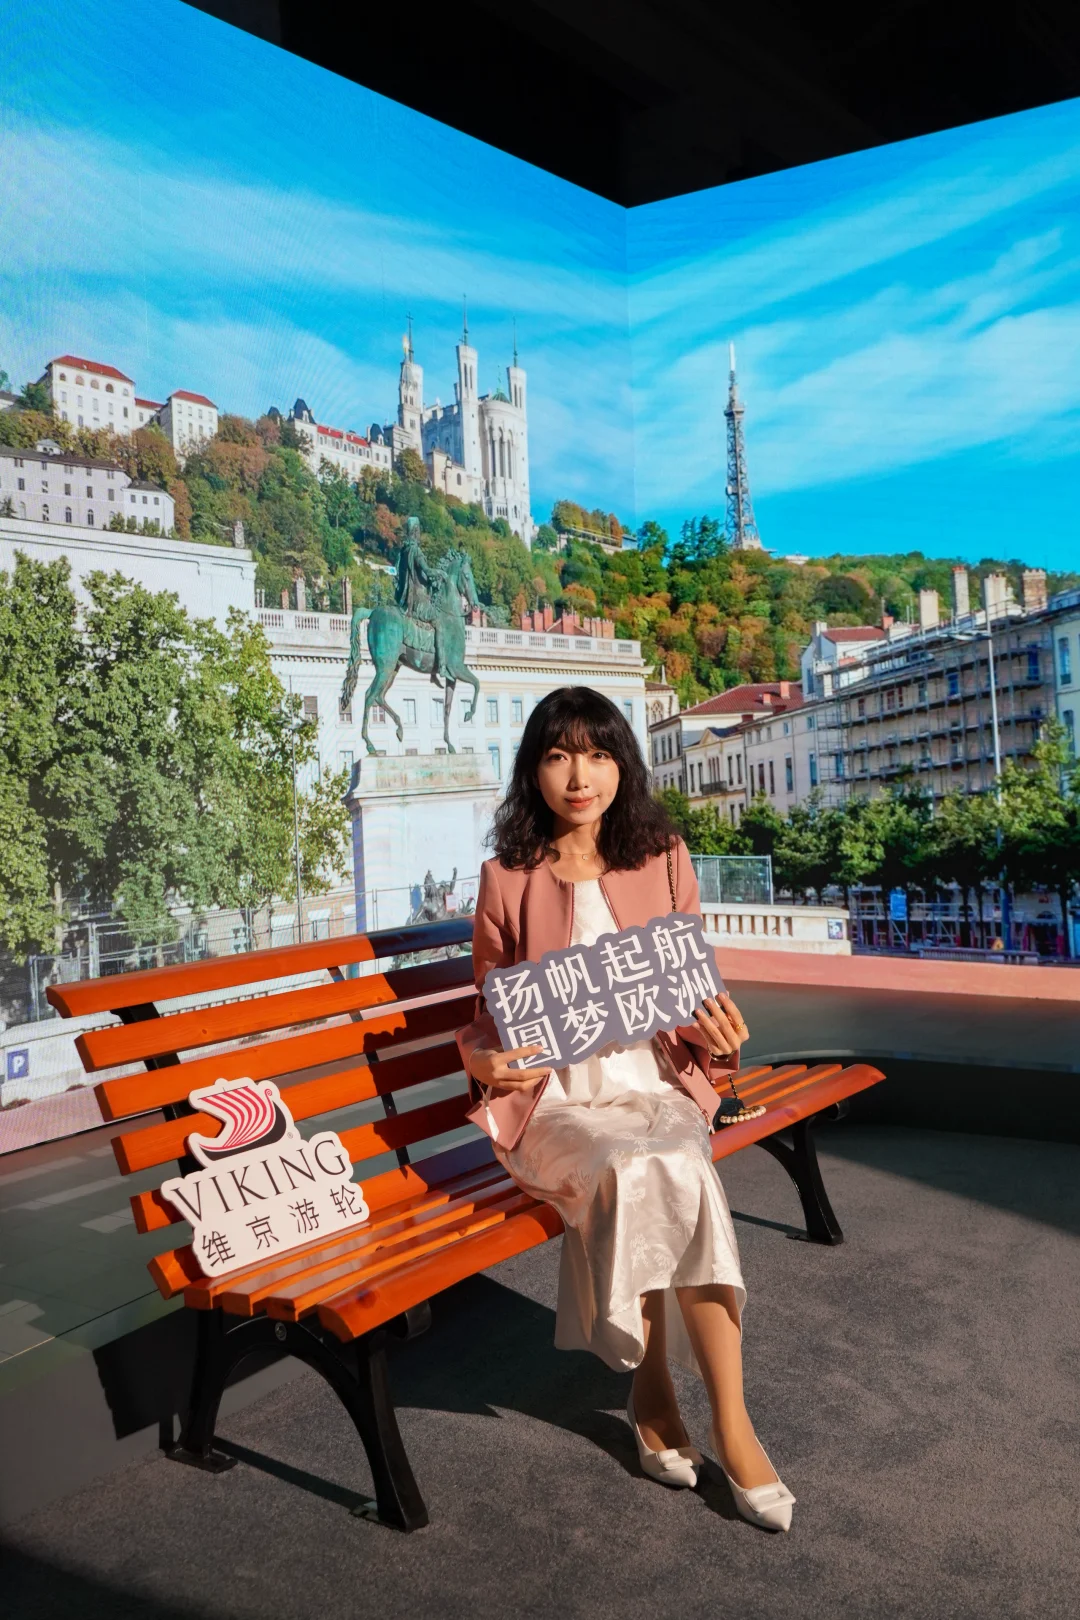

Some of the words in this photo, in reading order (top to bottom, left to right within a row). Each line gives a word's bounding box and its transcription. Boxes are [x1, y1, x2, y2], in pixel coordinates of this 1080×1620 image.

[491, 920, 707, 1024] 扬帆起航
[506, 962, 720, 1070] 圆梦欧洲
[13, 1055, 26, 1073] P
[170, 1139, 347, 1222] VIKING
[202, 1184, 363, 1267] 维京游轮
